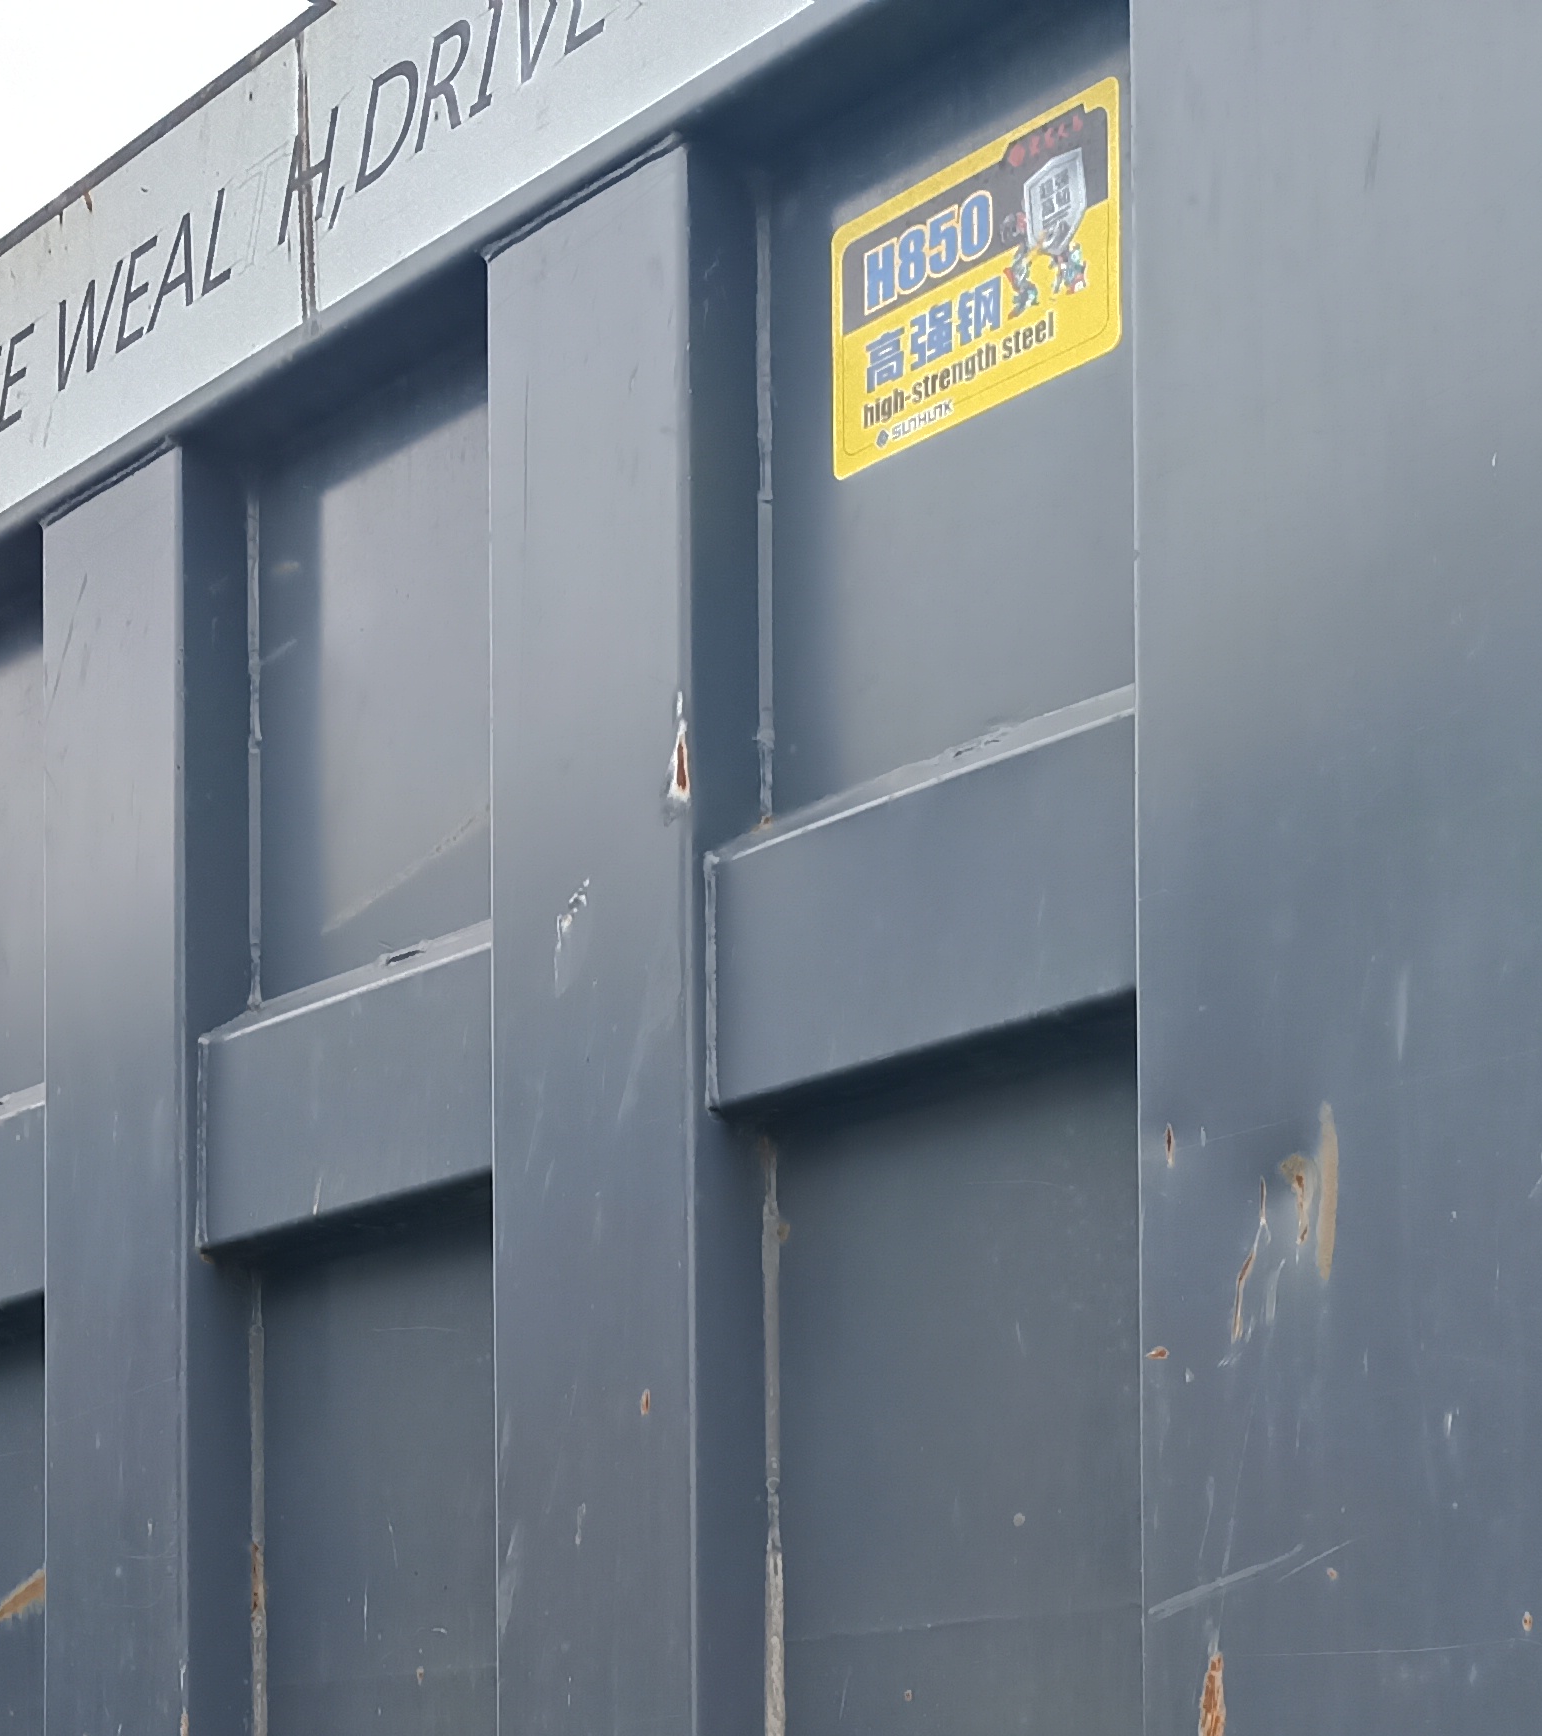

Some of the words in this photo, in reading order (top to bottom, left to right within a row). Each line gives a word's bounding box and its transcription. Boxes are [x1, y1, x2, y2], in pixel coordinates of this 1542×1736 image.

[864, 190, 993, 315] H850
[863, 342, 997, 430] high-strength
[1002, 310, 1056, 360] steel
[865, 276, 1002, 394] 高强钢
